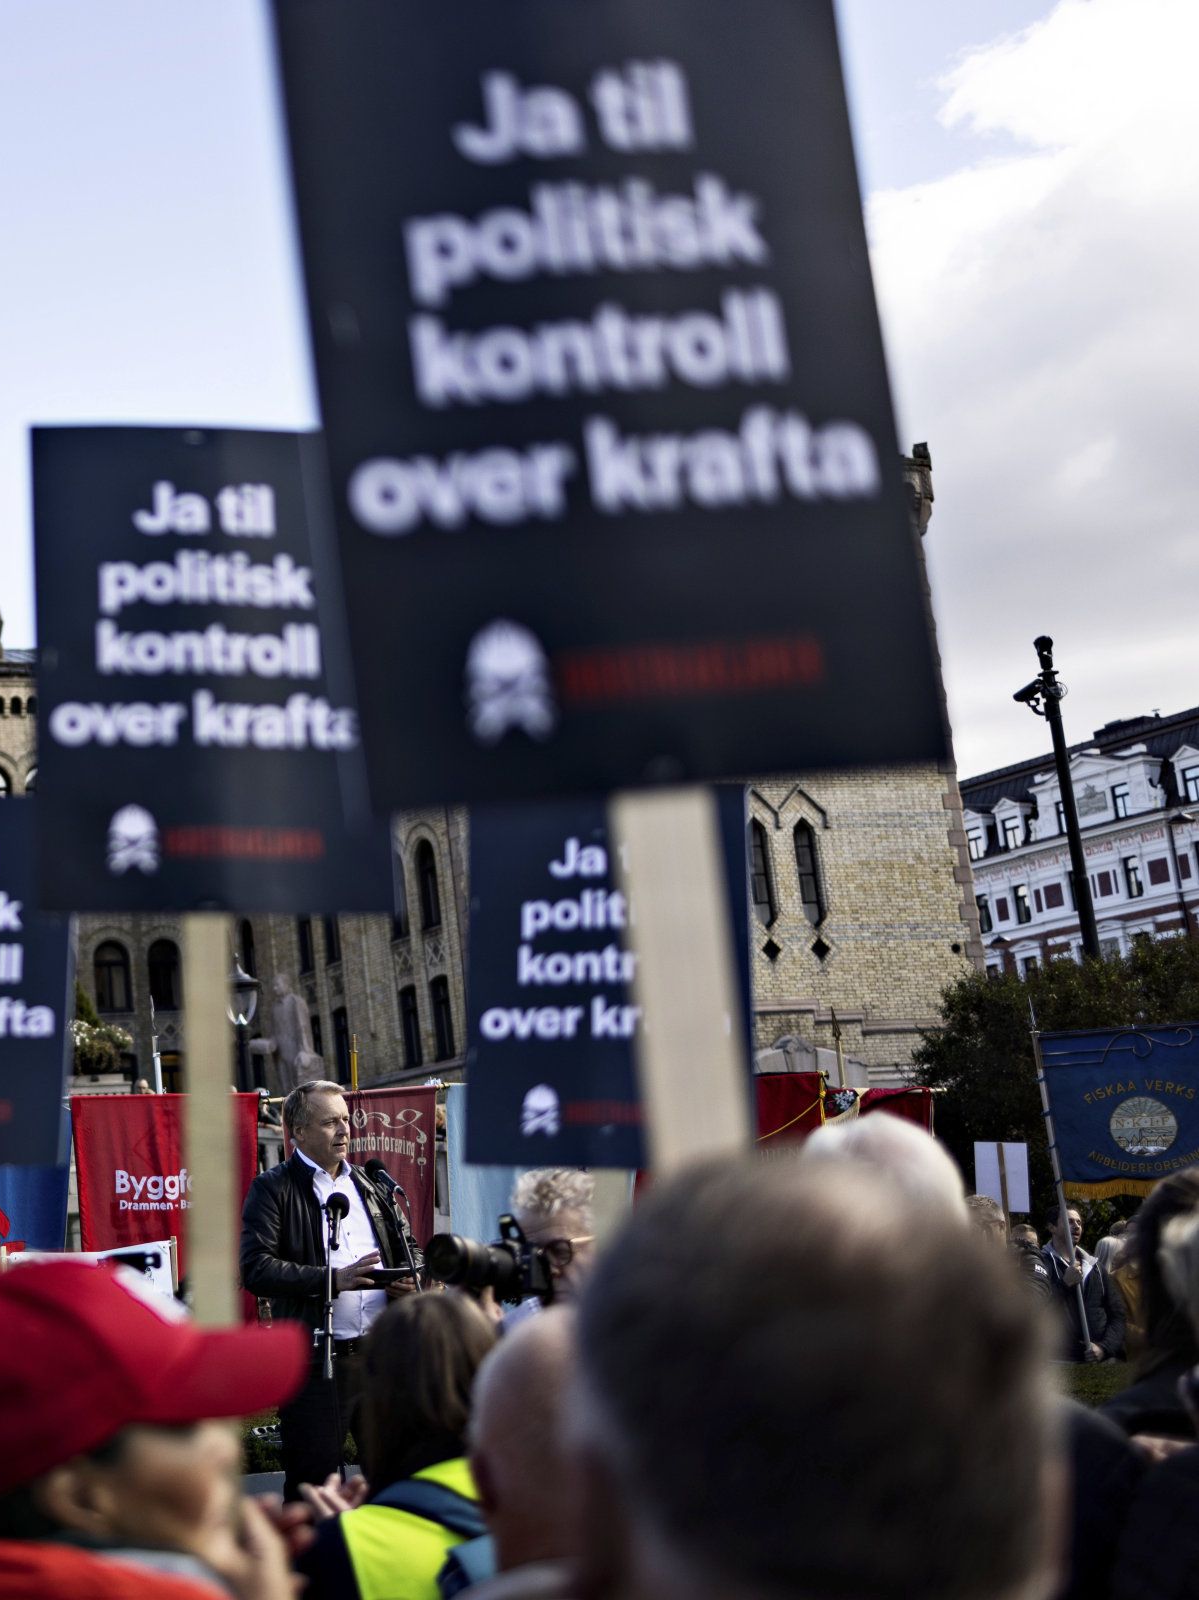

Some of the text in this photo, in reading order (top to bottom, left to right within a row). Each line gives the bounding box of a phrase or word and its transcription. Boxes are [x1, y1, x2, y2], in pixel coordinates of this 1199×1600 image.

[454, 58, 691, 163] Ja til
[404, 173, 768, 305] politisk
[408, 286, 789, 406] kontroll
[348, 406, 880, 534] over krafta
[133, 481, 276, 537] Ja til
[99, 549, 314, 615] politisk
[96, 619, 320, 678] kontroll
[49, 701, 186, 746] over
[549, 836, 607, 878] Ja
[520, 889, 627, 940] polit
[517, 944, 638, 986] kontr
[480, 996, 642, 1039] over kr
[1083, 1080, 1137, 1104] FISKAA
[120, 1200, 173, 1211] Drammen
